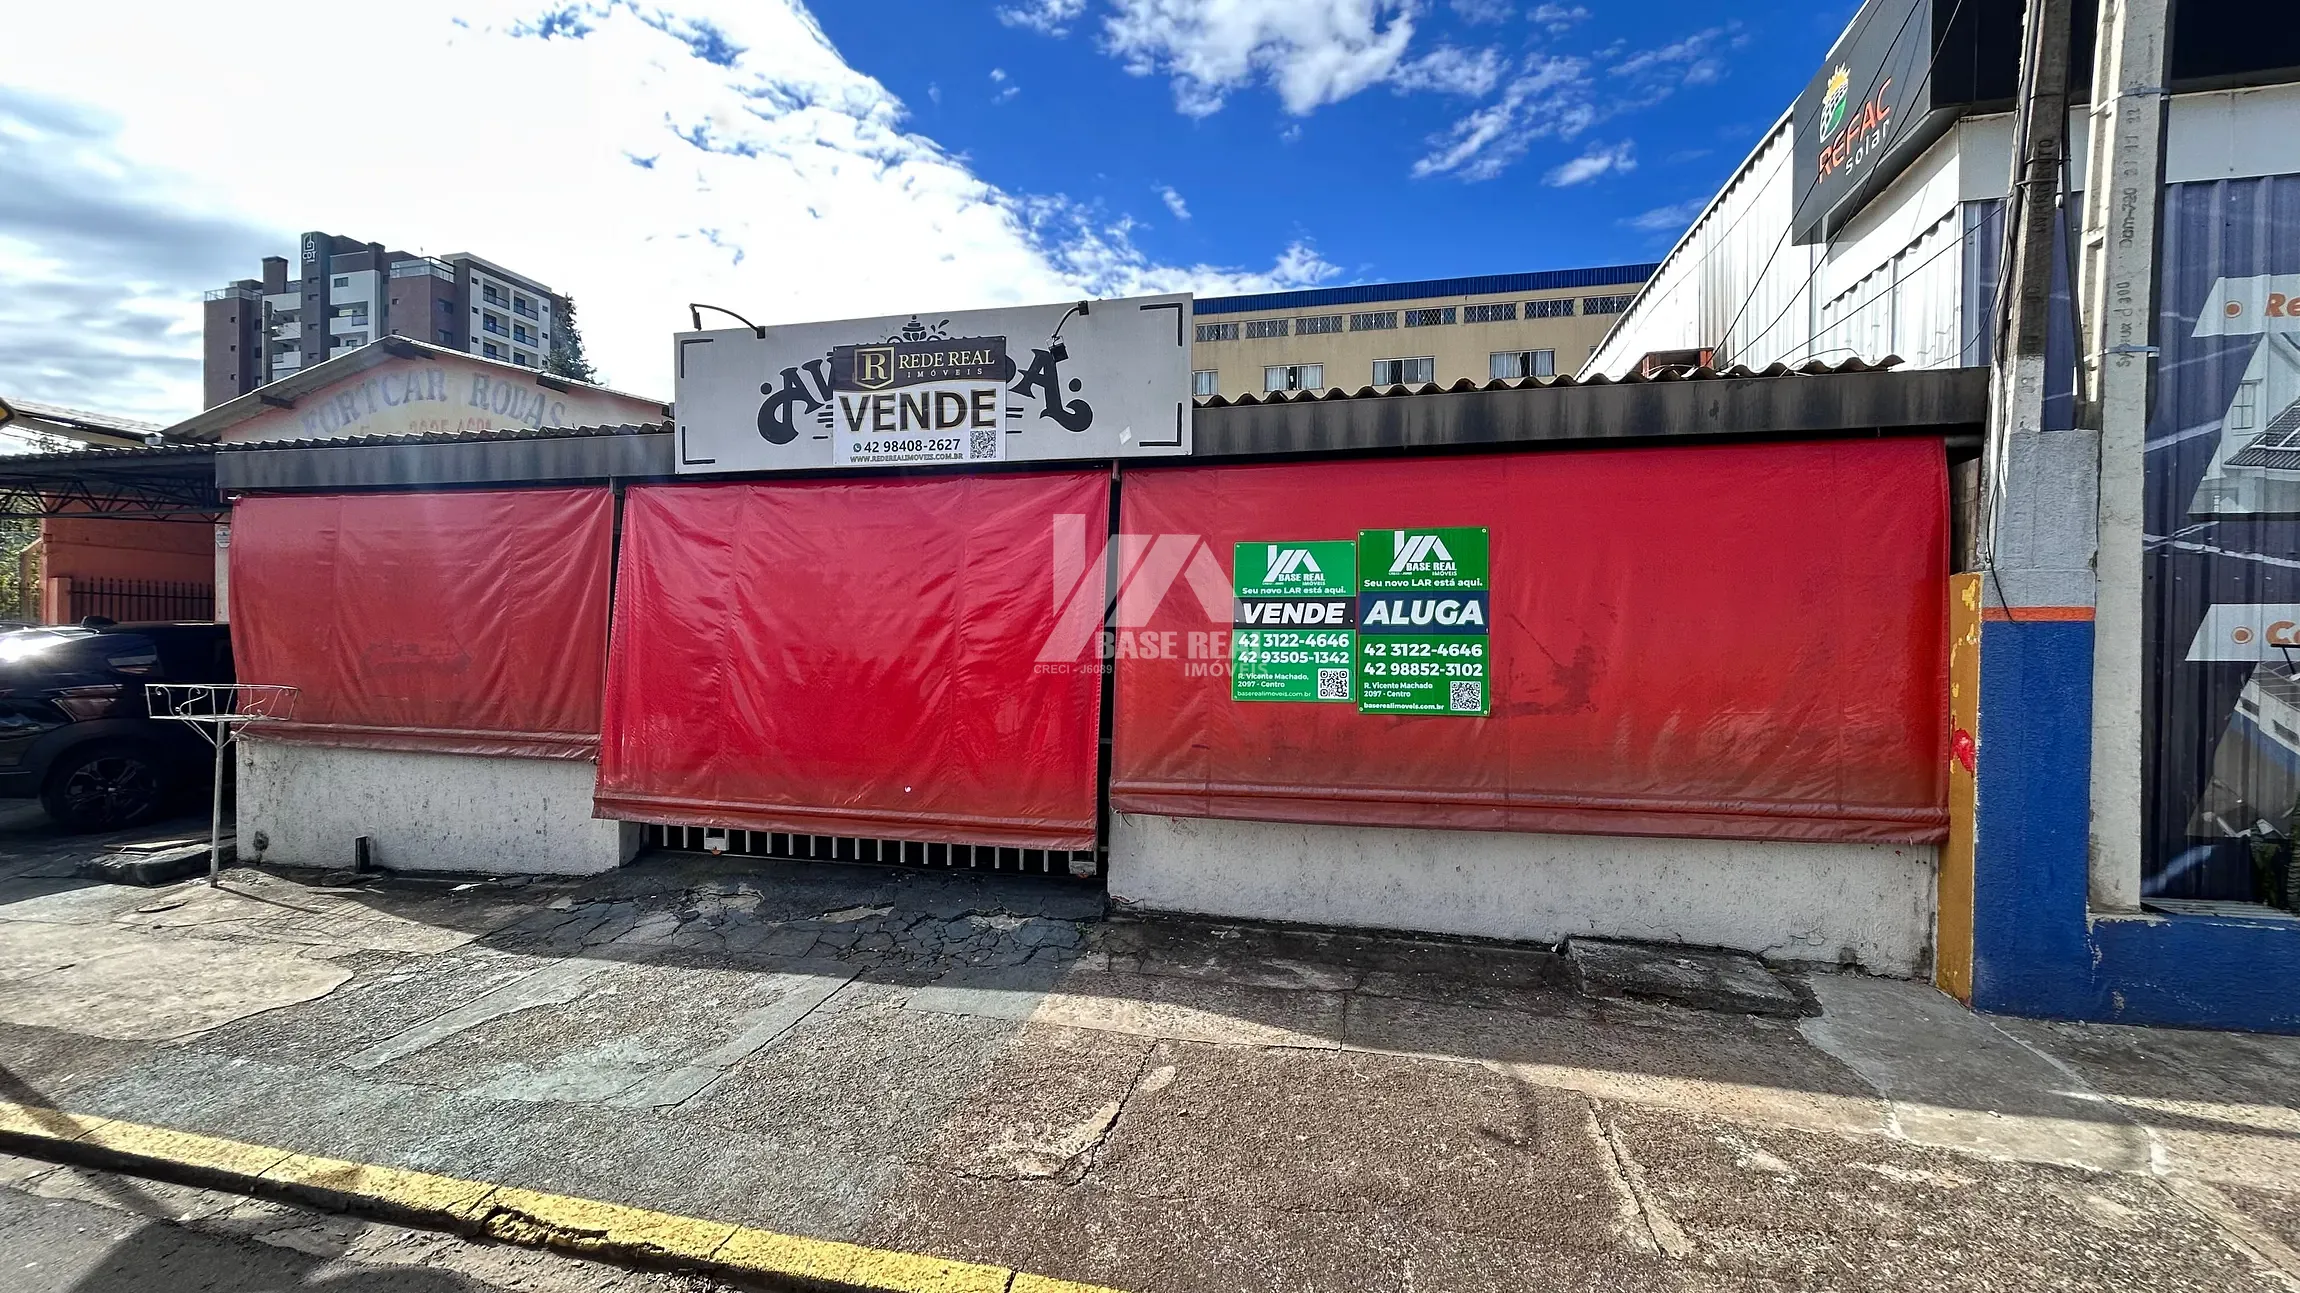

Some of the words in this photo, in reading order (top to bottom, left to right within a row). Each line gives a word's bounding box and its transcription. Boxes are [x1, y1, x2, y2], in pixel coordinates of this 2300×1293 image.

[1818, 77, 1892, 184] REFAC
[1845, 119, 1890, 176] solar
[861, 353, 888, 381] R
[899, 352, 944, 369] REDE
[948, 350, 995, 366] REAL
[907, 368, 983, 378] IMÓVEIS
[301, 367, 448, 436] FORTCAR
[468, 372, 567, 428] RODAS
[838, 388, 997, 432] VENDE
[864, 441, 880, 453] 42
[883, 438, 961, 452] 98408-2627
[1406, 562, 1431, 571] BASE
[1433, 562, 1457, 571] REAL
[1279, 573, 1301, 581] BASE
[1303, 573, 1325, 581] REAL
[1364, 579, 1383, 587] Seu
[1434, 578, 1455, 586] está
[1458, 578, 1483, 588] aqui.
[1324, 586, 1346, 595] aqui.
[1243, 603, 1346, 624] VENDE
[1363, 600, 1484, 625] ALUGA
[1238, 634, 1259, 647] 42
[1263, 634, 1349, 647] 3122-4646
[1364, 643, 1386, 656] 42
[1390, 643, 1483, 657] 3122-4646
[1238, 652, 1258, 664] 42
[1261, 652, 1349, 664] 93505-1342
[1364, 662, 1386, 676] 42
[1390, 663, 1483, 677] 98852-3102
